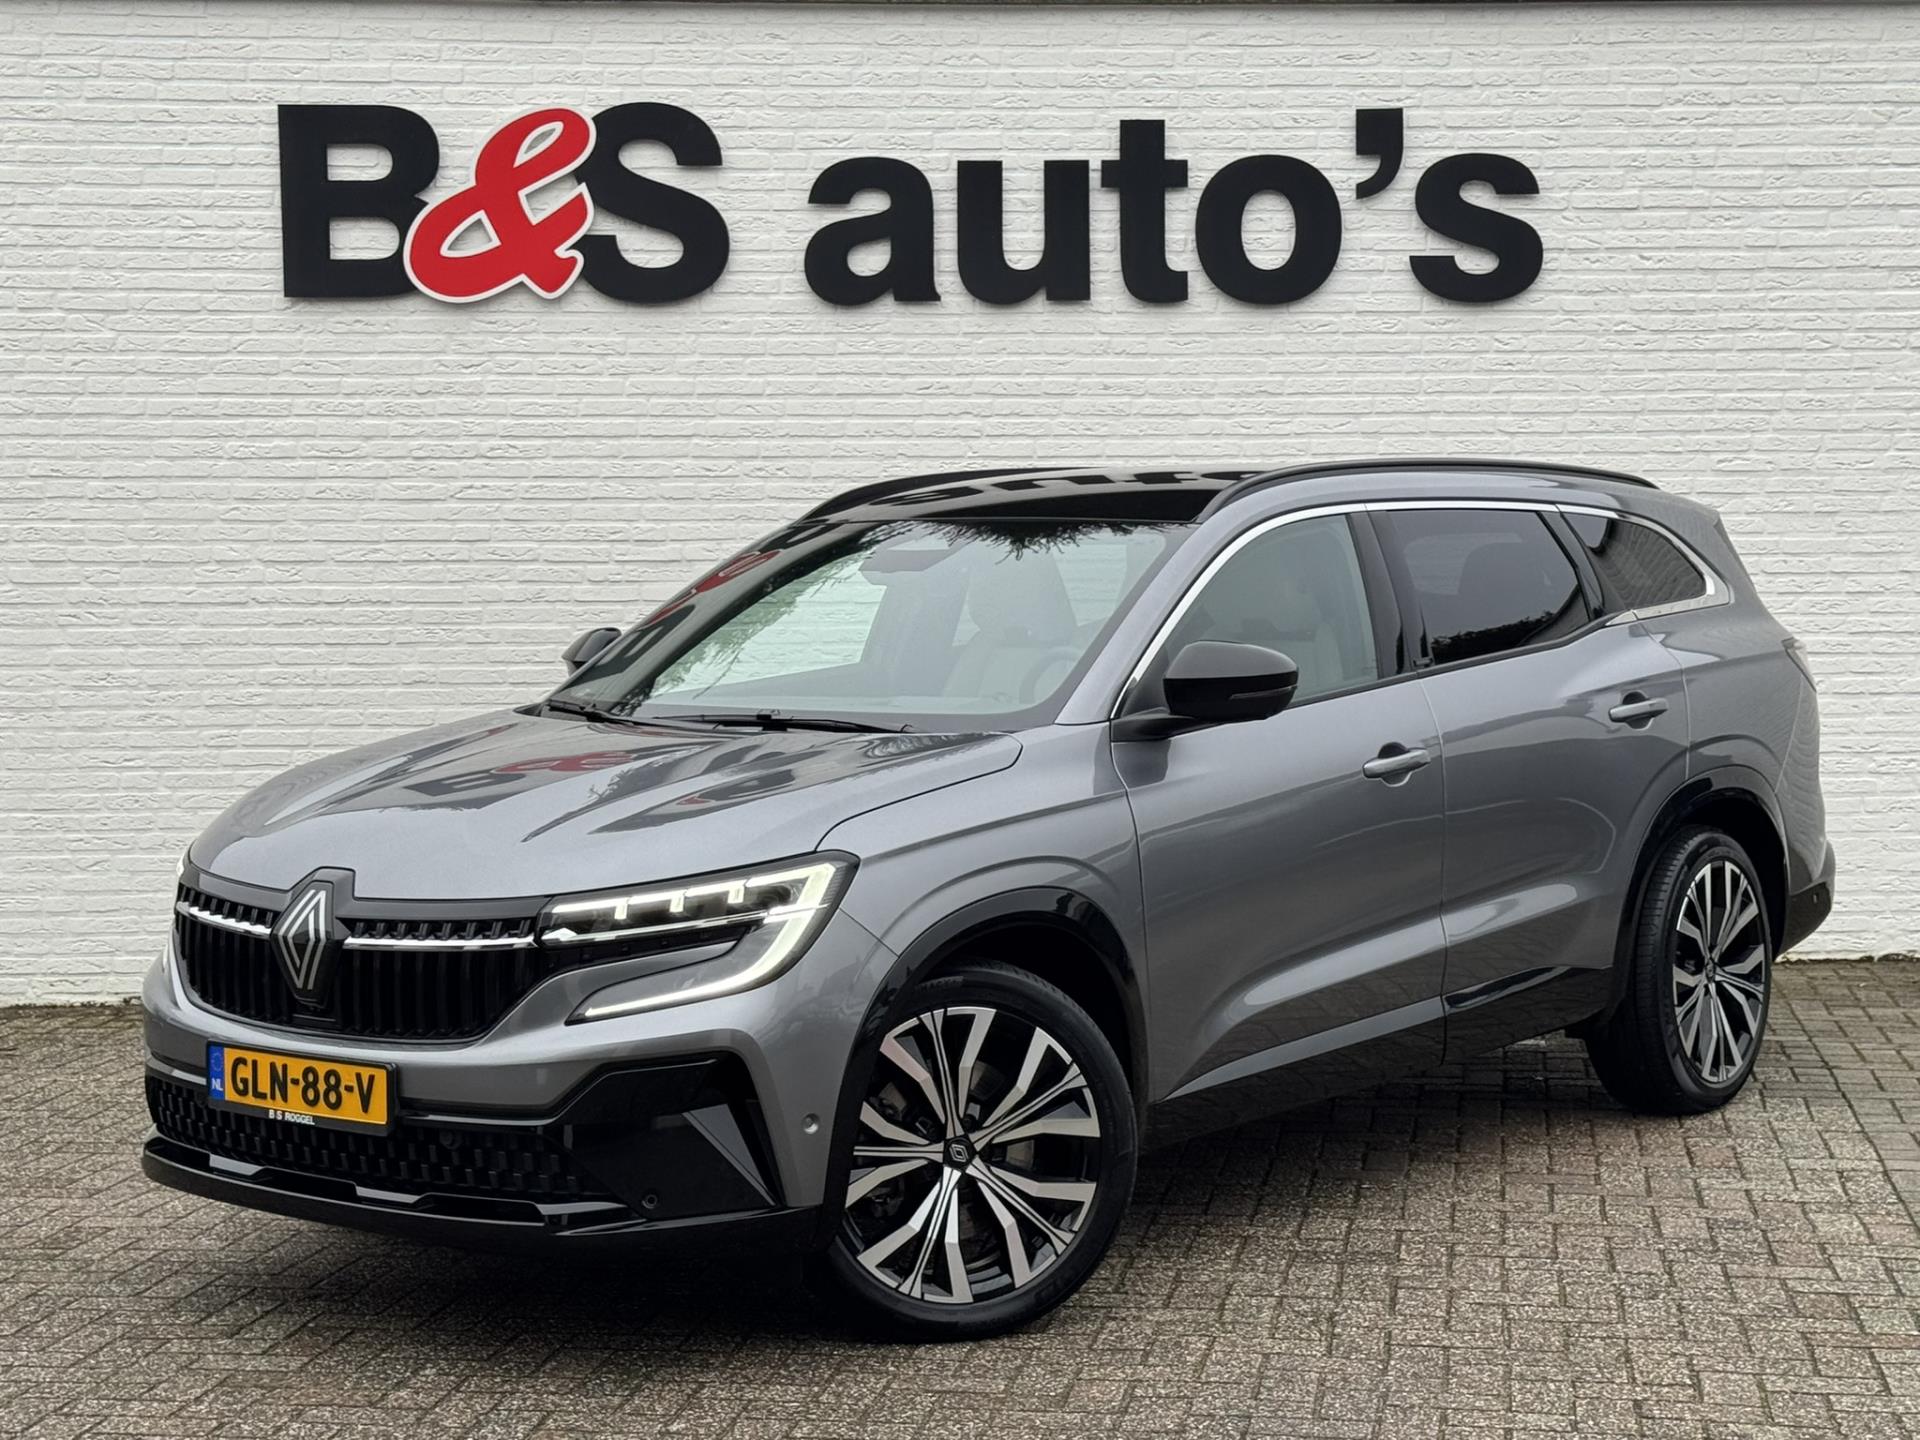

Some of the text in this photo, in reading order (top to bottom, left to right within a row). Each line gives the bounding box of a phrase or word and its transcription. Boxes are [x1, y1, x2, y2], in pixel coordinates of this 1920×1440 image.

[278, 102, 1544, 304] B&S auto's
[211, 1056, 375, 1114] NL GLN-88-V
